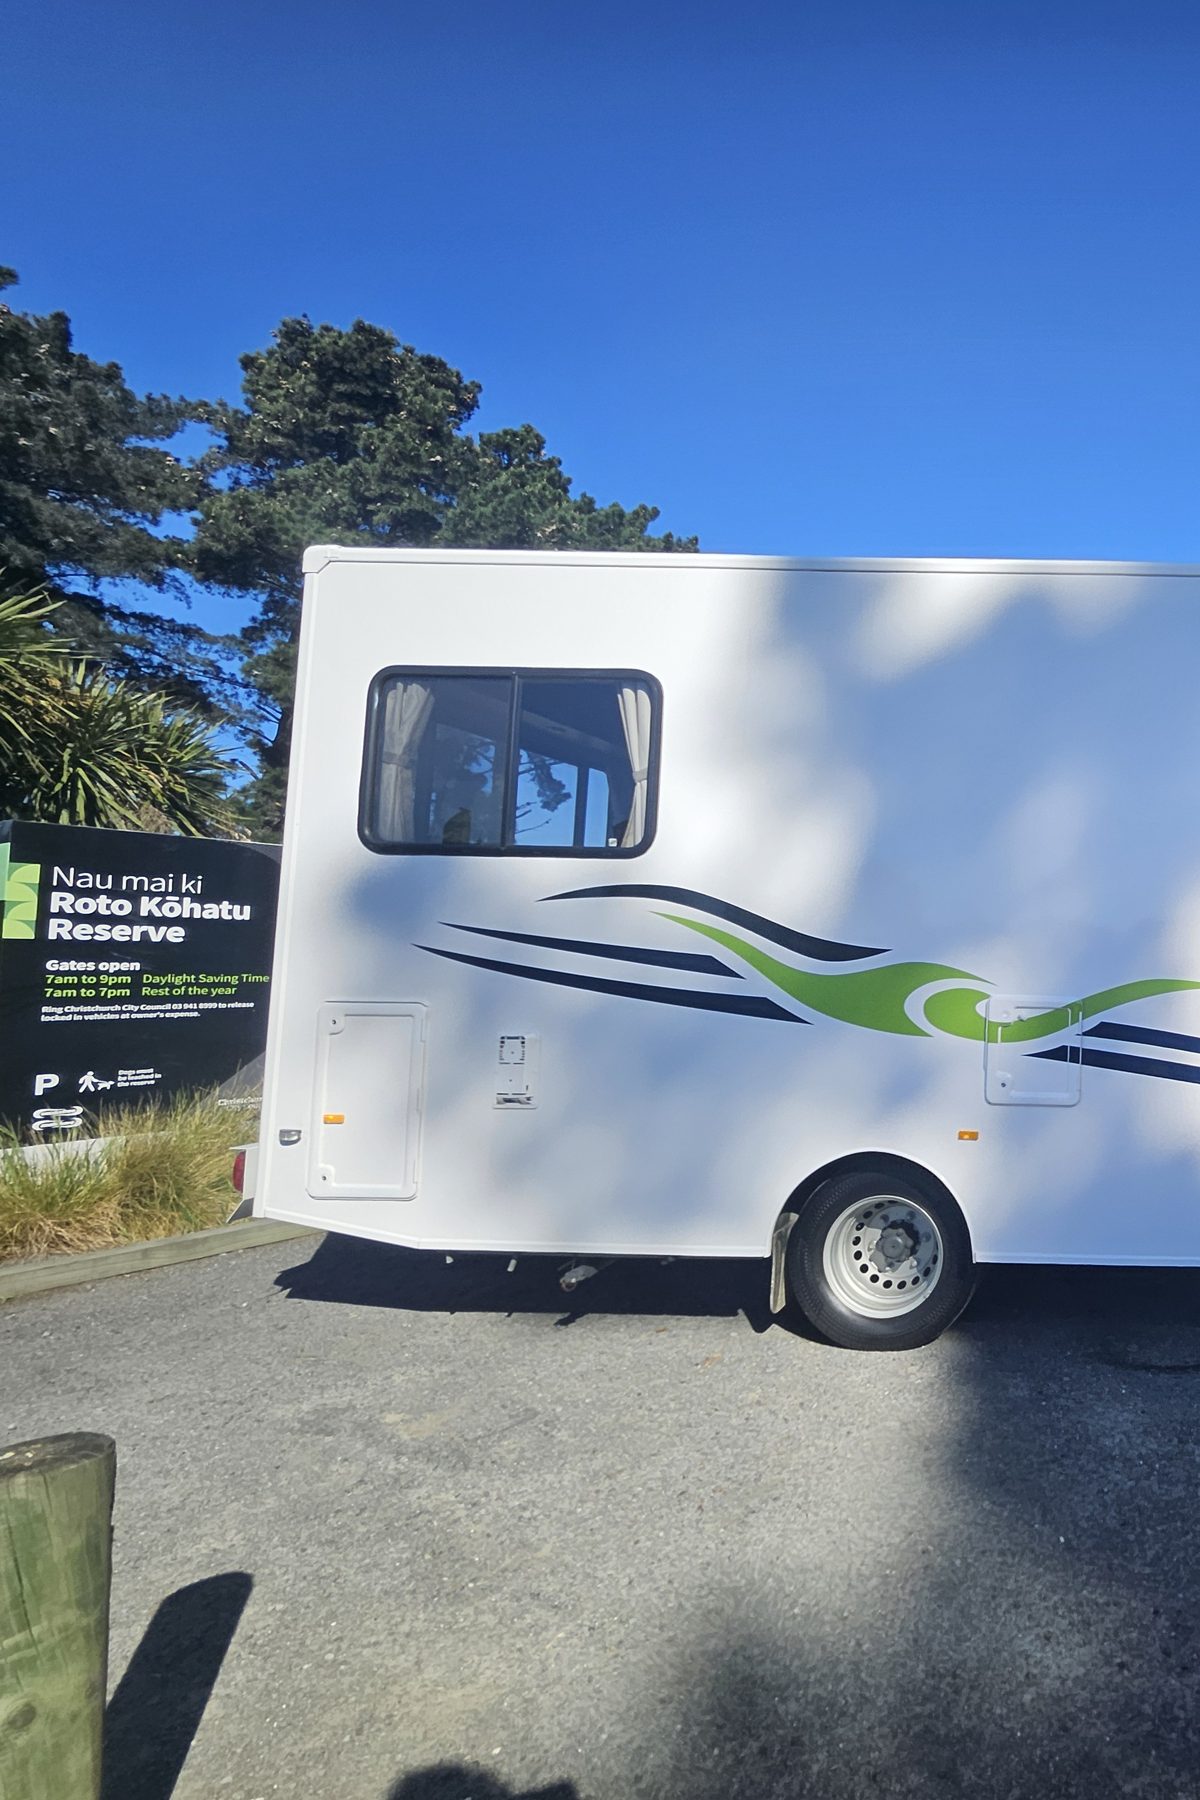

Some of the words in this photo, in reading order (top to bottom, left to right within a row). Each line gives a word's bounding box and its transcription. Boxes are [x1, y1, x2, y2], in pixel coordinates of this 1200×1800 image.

[52, 866, 113, 889] Nau
[121, 873, 174, 892] mai
[181, 873, 203, 894] ki
[50, 891, 133, 916] Roto
[139, 895, 251, 921] Kōhatu
[48, 918, 186, 943] Reserve
[45, 960, 96, 971] Gates
[98, 962, 141, 973] open
[45, 974, 78, 984] 7am
[81, 975, 97, 984] to
[100, 974, 131, 985] 9pm
[142, 973, 196, 985] Daylight
[198, 974, 239, 984] Saving
[240, 973, 270, 983] Time
[44, 988, 77, 997] 7am
[80, 988, 96, 997] to
[99, 987, 131, 998] 7pm
[141, 986, 170, 996] Rest
[172, 986, 186, 996] of
[188, 986, 209, 995] the
[211, 987, 238, 997] year
[41, 1006, 64, 1014] Ring
[64, 1005, 121, 1013] Christchurch
[122, 1004, 139, 1012] City
[140, 1003, 171, 1011] Council
[34, 1073, 60, 1096] P
